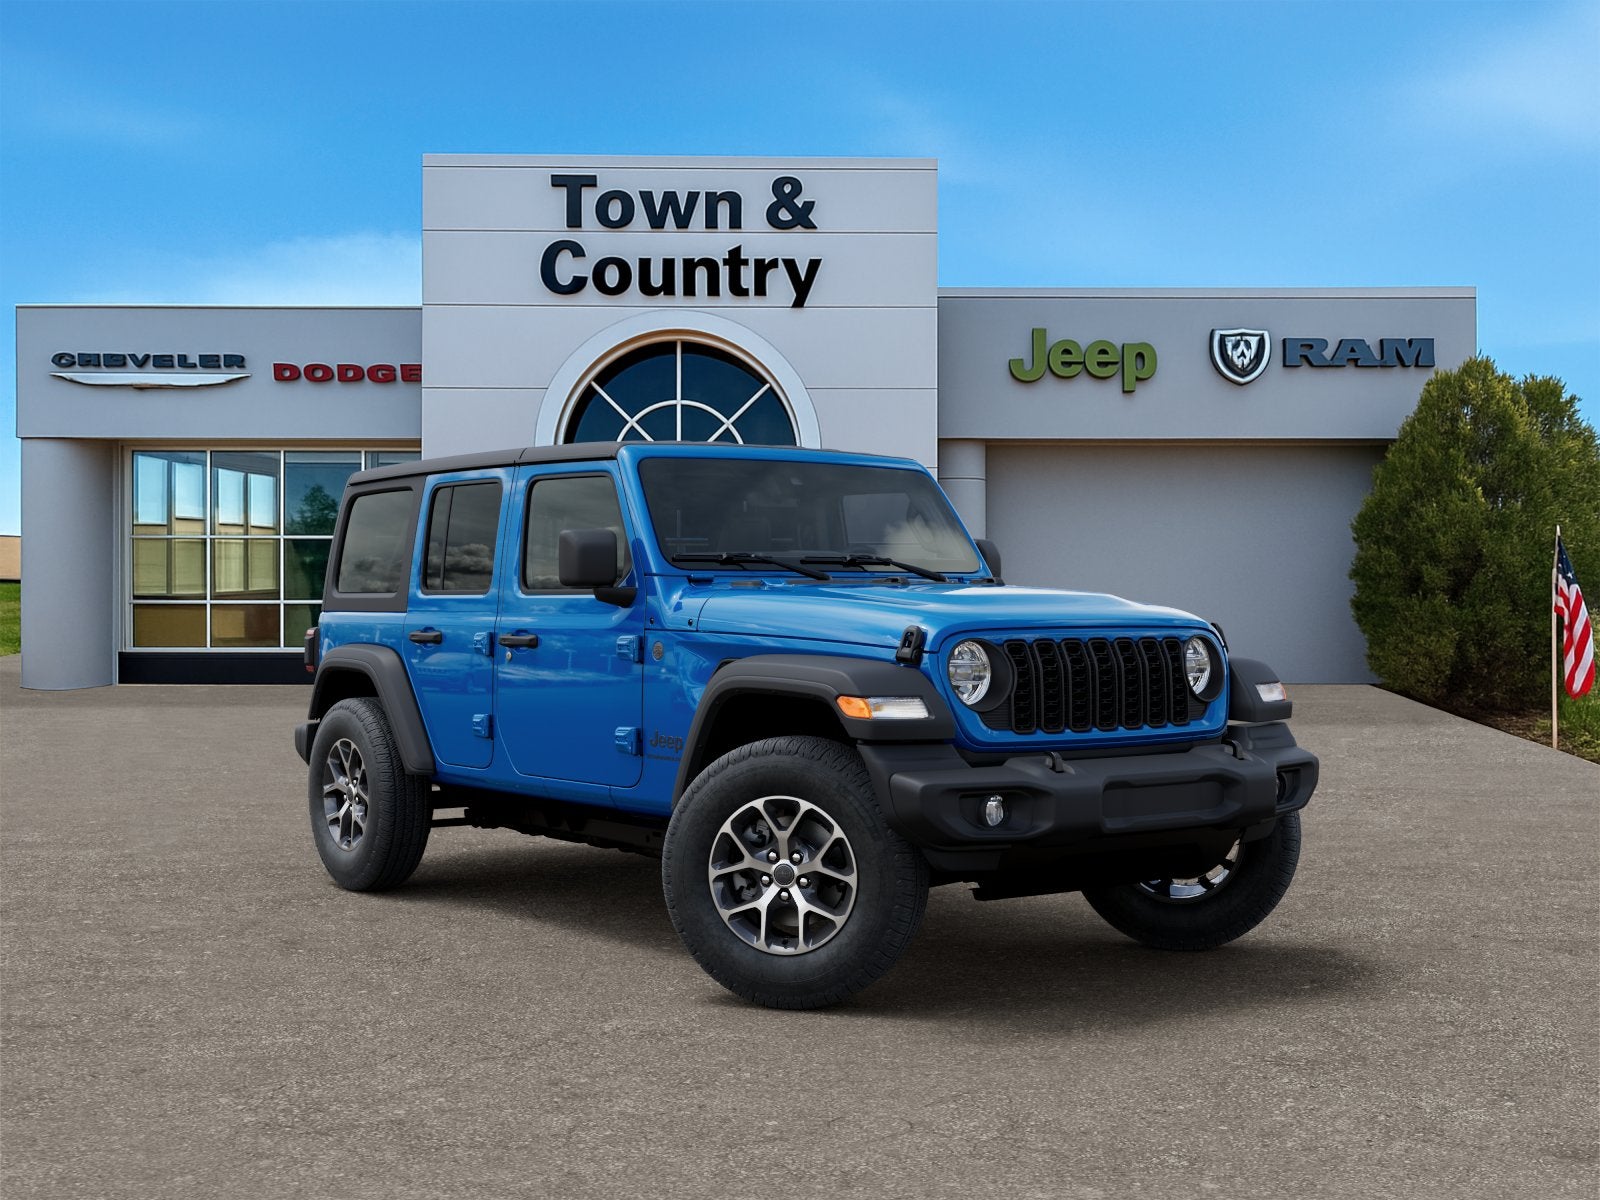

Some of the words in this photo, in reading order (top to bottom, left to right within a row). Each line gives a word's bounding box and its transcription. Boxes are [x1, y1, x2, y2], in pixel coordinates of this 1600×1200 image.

[550, 174, 743, 230] Town
[765, 175, 818, 231] &
[539, 239, 823, 309] Country
[272, 363, 422, 384] DODGE
[1008, 327, 1158, 393] Jeep
[1282, 337, 1436, 368] RAM
[649, 728, 684, 753] Jeep
